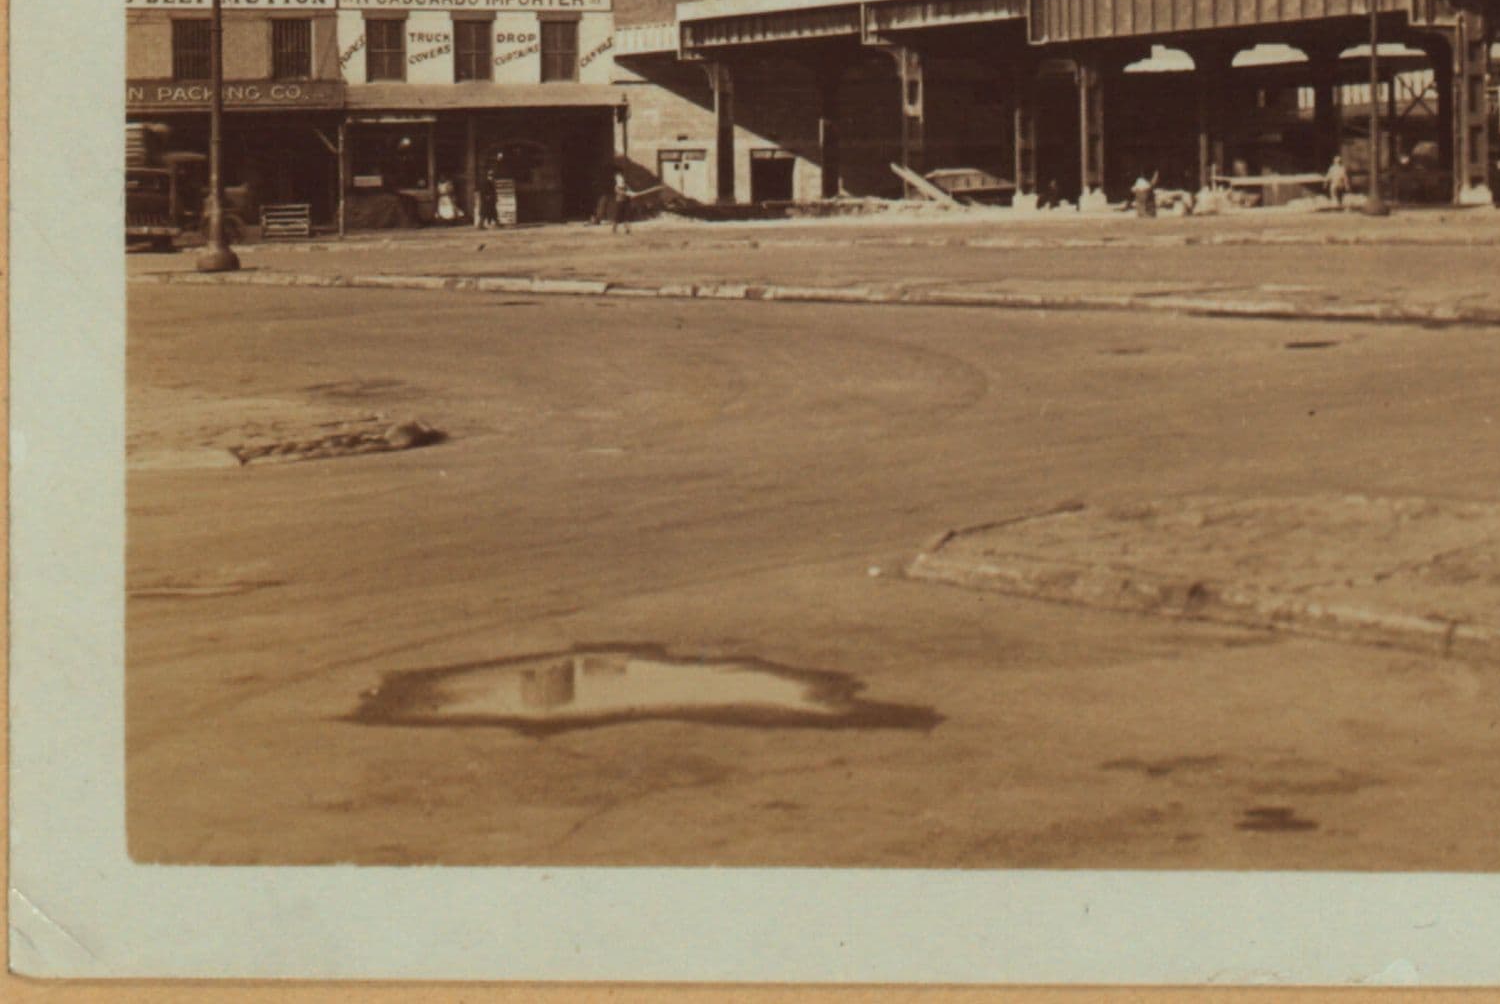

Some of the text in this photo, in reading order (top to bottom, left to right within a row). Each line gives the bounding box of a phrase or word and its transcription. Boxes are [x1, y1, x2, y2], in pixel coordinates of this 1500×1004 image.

[496, 32, 537, 43] DROP
[408, 32, 451, 65] TRUCK COVERS
[157, 86, 260, 101] PACKNG
